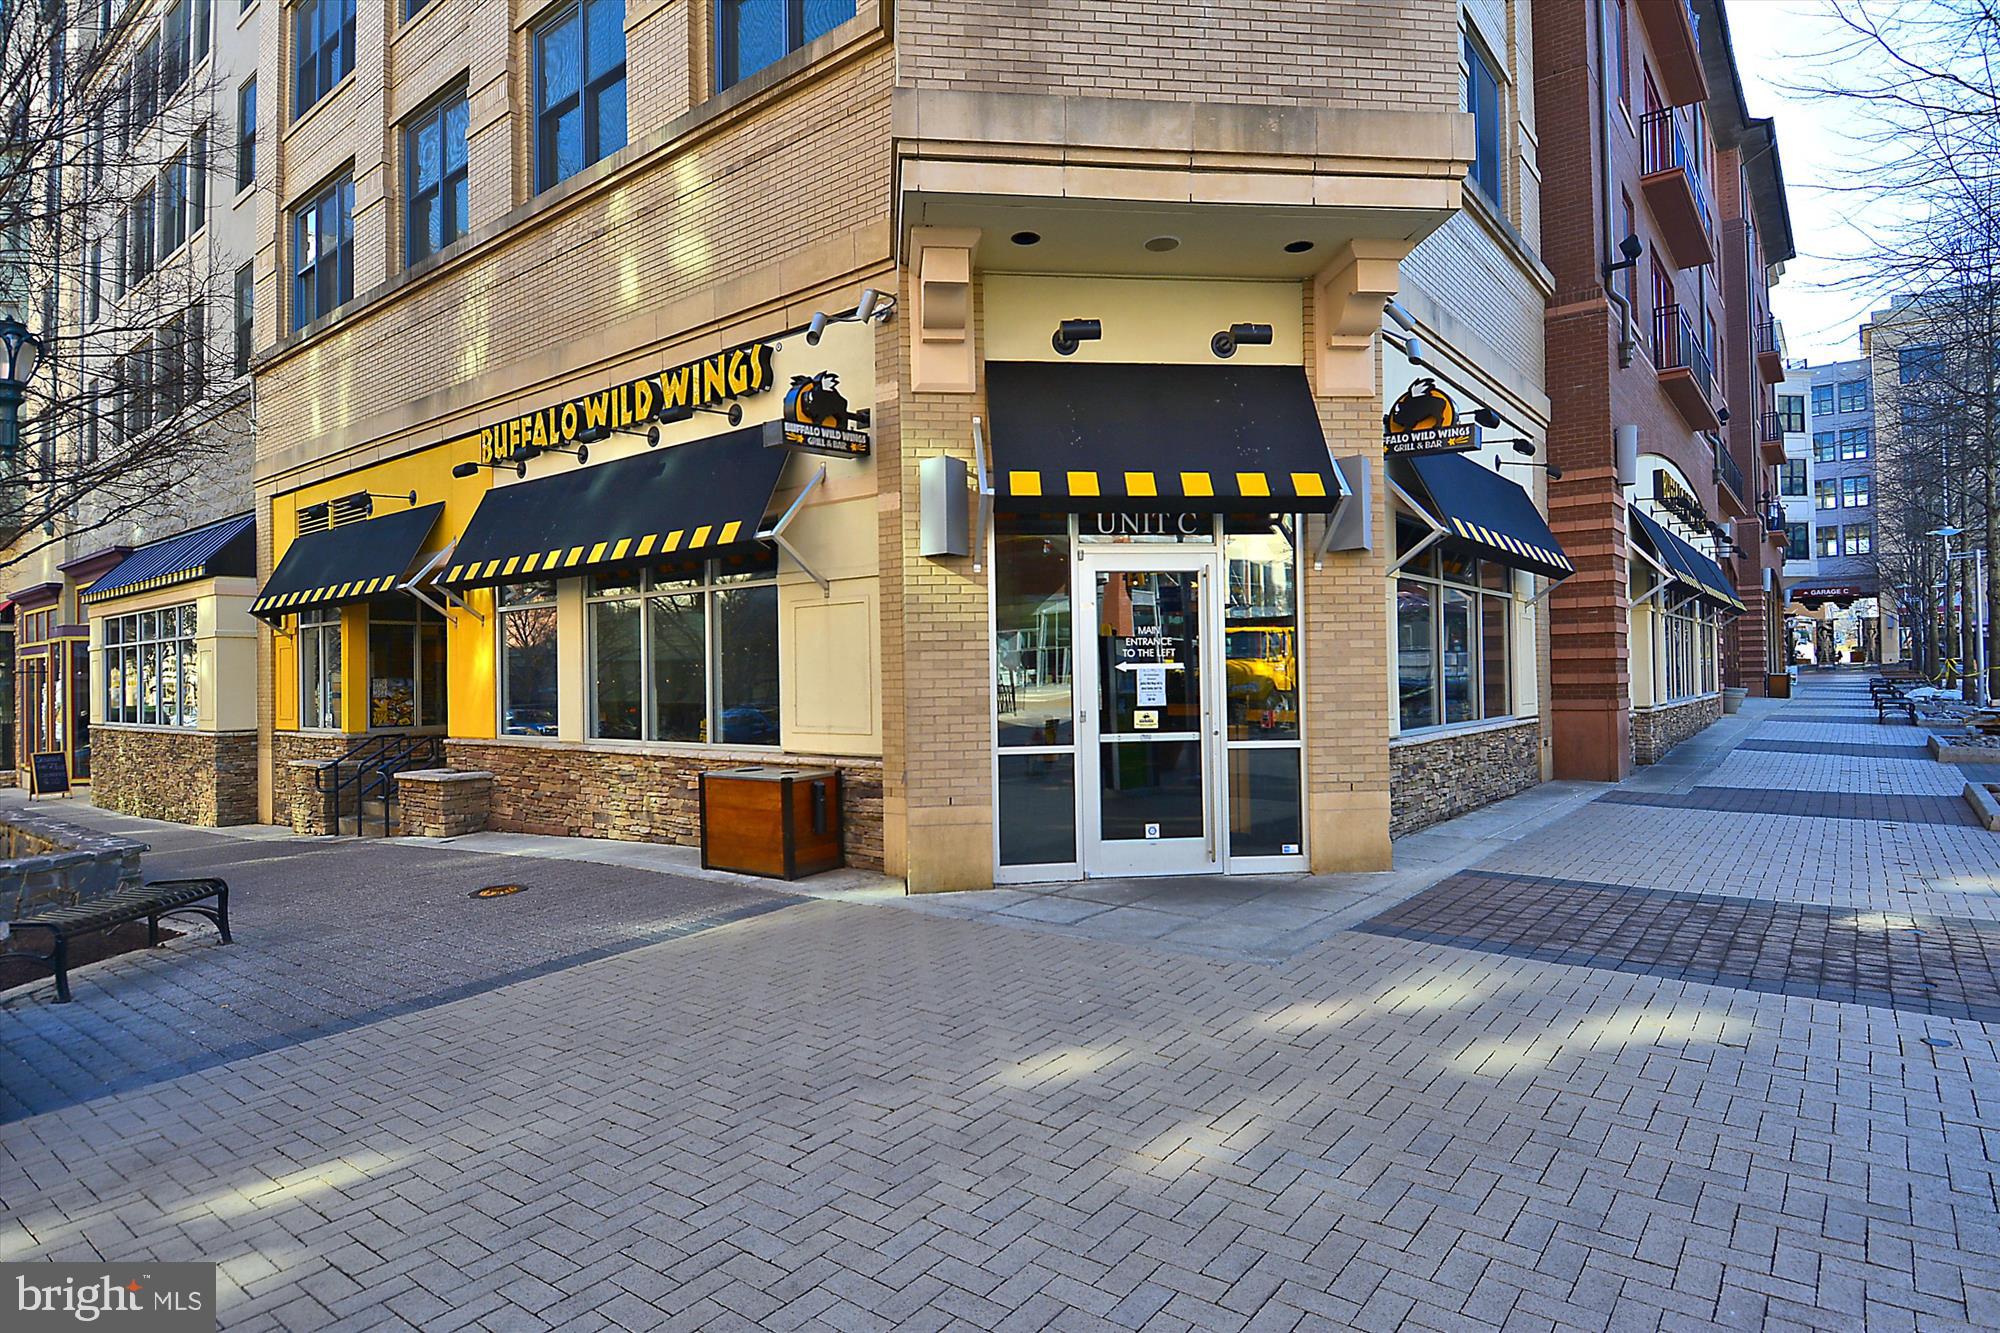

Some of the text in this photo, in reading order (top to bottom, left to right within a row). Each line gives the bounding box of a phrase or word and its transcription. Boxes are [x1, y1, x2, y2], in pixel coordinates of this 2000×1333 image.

[481, 343, 763, 464] BUFFALO WILD WINGS
[784, 421, 867, 444] BUFFALO WILD WINGS
[1411, 430, 1437, 442] WILD
[1438, 426, 1470, 439] WINGS
[807, 436, 826, 447] GRILL
[833, 440, 848, 450] BAR
[1394, 439, 1443, 452] GRILL & BAR
[1097, 512, 1197, 534] UNIT C
[1810, 588, 1841, 596] GARAGE
[1137, 625, 1161, 635] MAIN
[1125, 637, 1173, 646] ENTRANCE
[1122, 648, 1176, 658] TO THE LEFT
